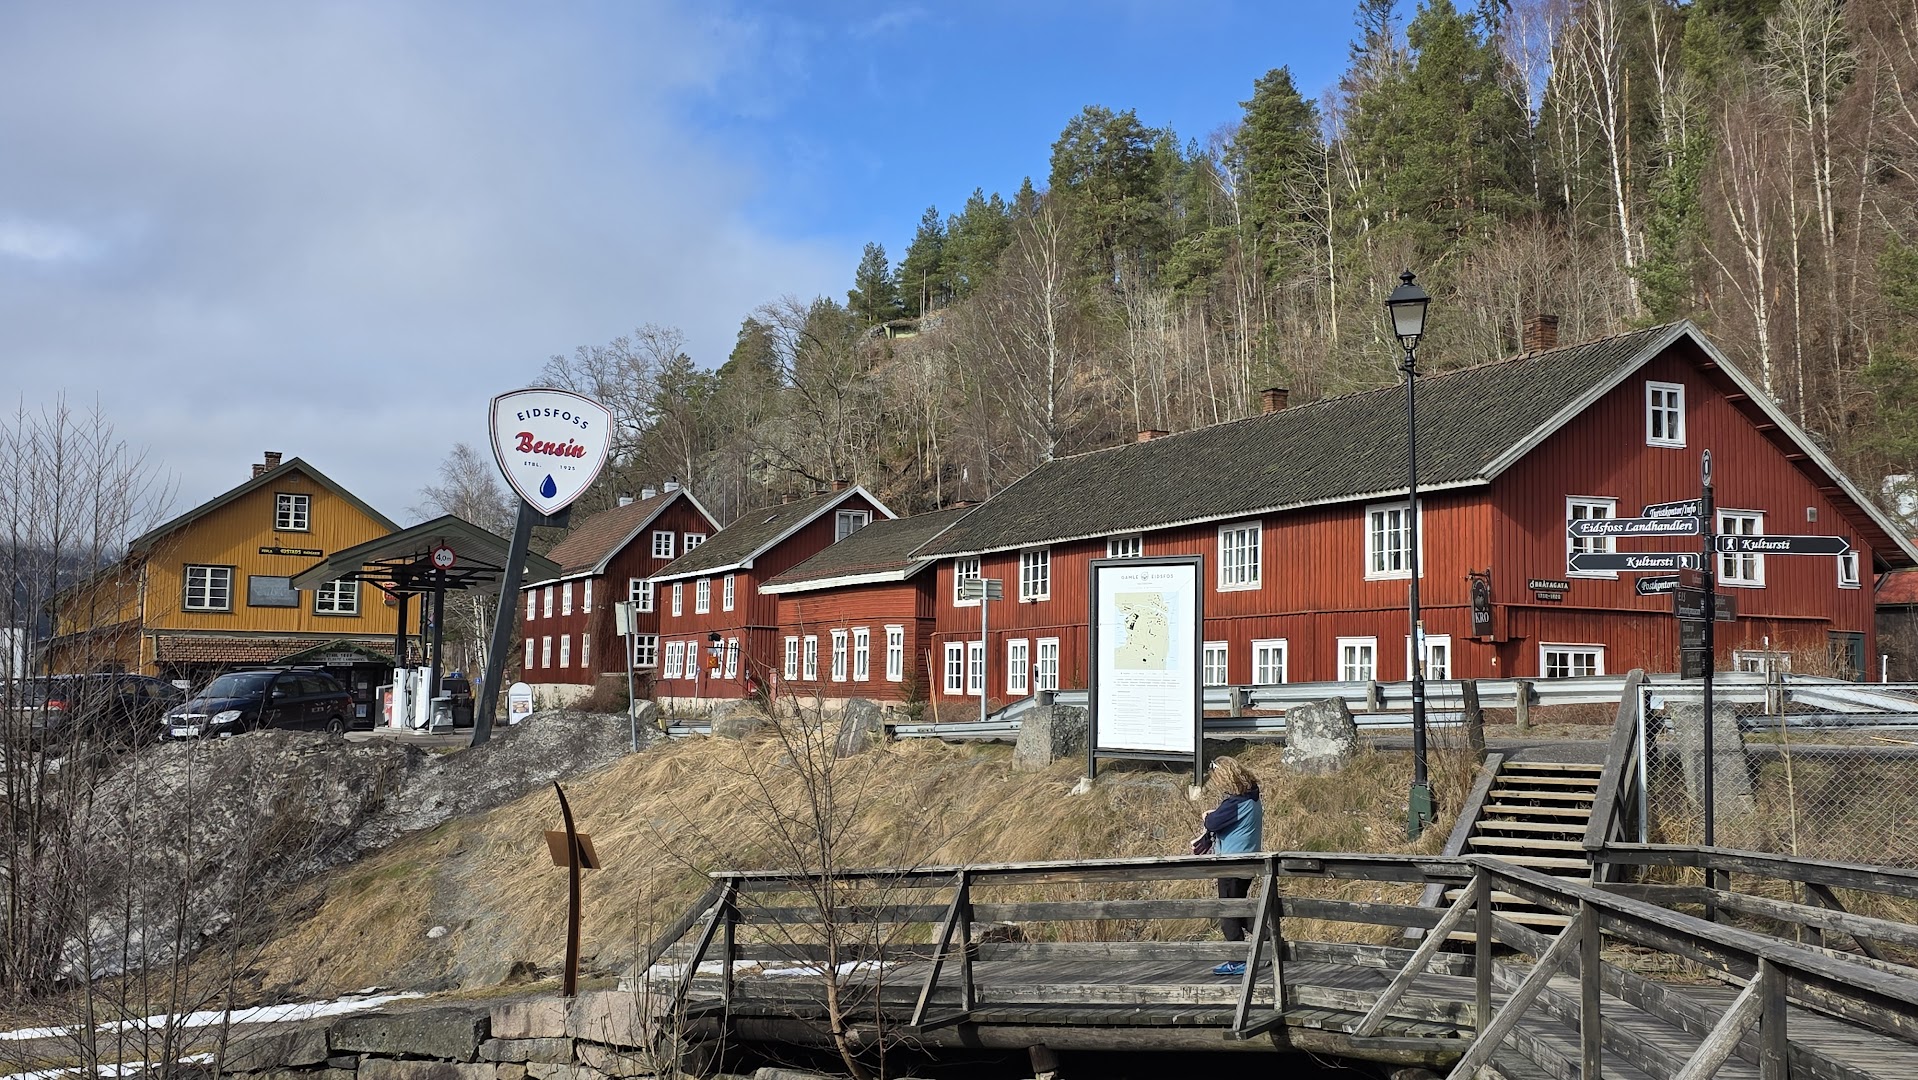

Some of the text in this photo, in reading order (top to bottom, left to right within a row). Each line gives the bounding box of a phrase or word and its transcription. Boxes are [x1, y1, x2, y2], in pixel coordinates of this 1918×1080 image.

[517, 408, 589, 429] EIDSFOSS
[515, 431, 587, 459] Bensin
[1580, 520, 1693, 535] Eidsfoss Landhandleri
[1742, 538, 1791, 551] Kultursti
[1625, 556, 1674, 568] Kultursti
[1534, 580, 1568, 589] BRÅTAGATA
[1475, 612, 1489, 623] KRO
